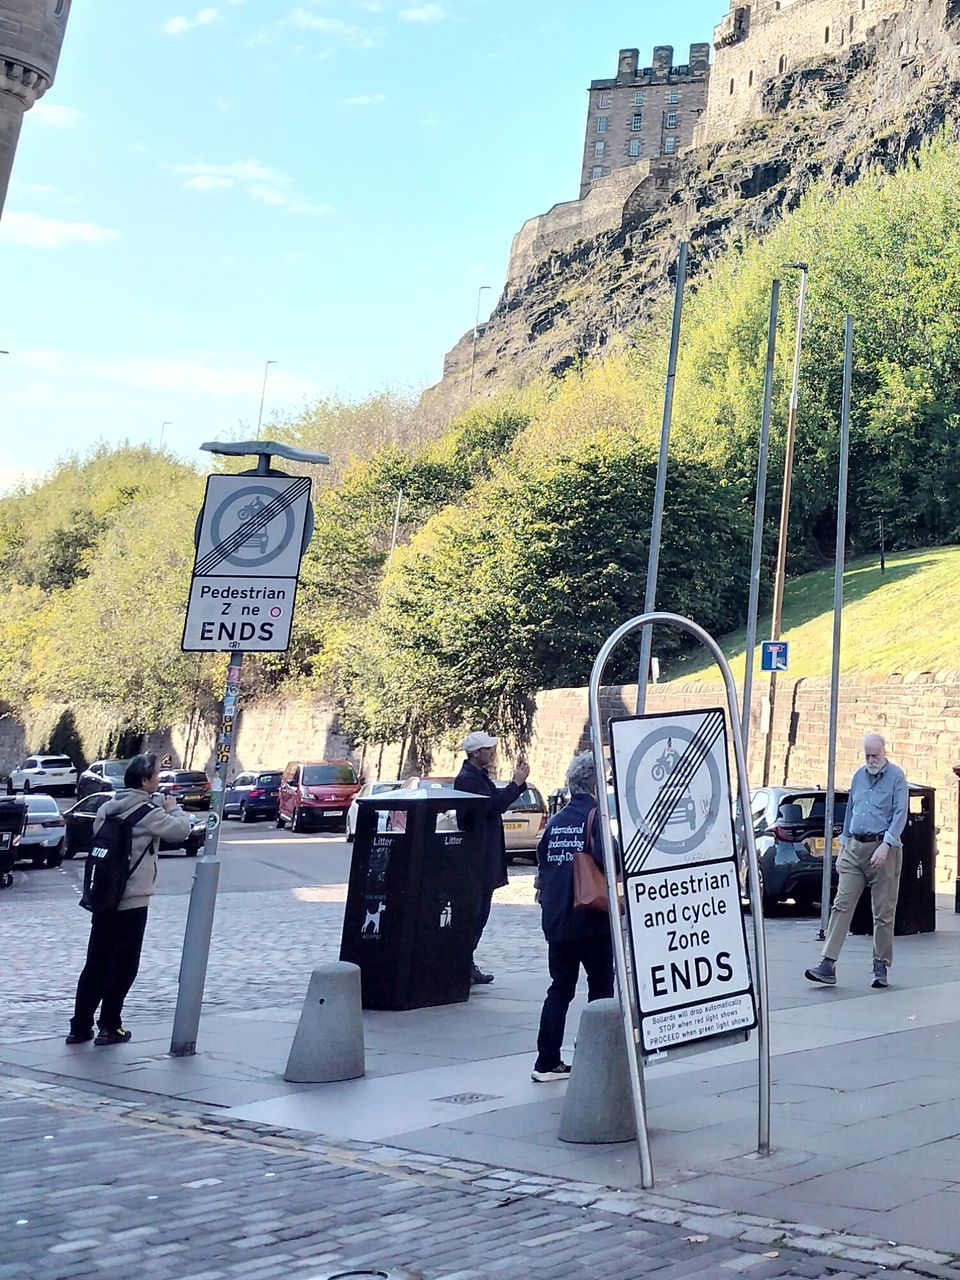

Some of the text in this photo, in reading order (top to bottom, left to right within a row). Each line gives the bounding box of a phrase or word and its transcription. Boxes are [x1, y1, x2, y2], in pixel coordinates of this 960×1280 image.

[200, 586, 286, 599] Pedestrian
[221, 603, 260, 616] Zne
[200, 622, 274, 641] ENDS
[373, 837, 392, 846] Litter
[445, 836, 462, 845] Litter
[635, 872, 730, 903] Pedestrian
[644, 896, 727, 928] and cycle
[667, 929, 710, 952] Zone
[651, 951, 733, 997] ENDS
[652, 999, 742, 1025] Bollards will drop automatically
[659, 1009, 738, 1033] STOP when red light shows
[649, 1016, 749, 1046] PROCEED when green light shows
